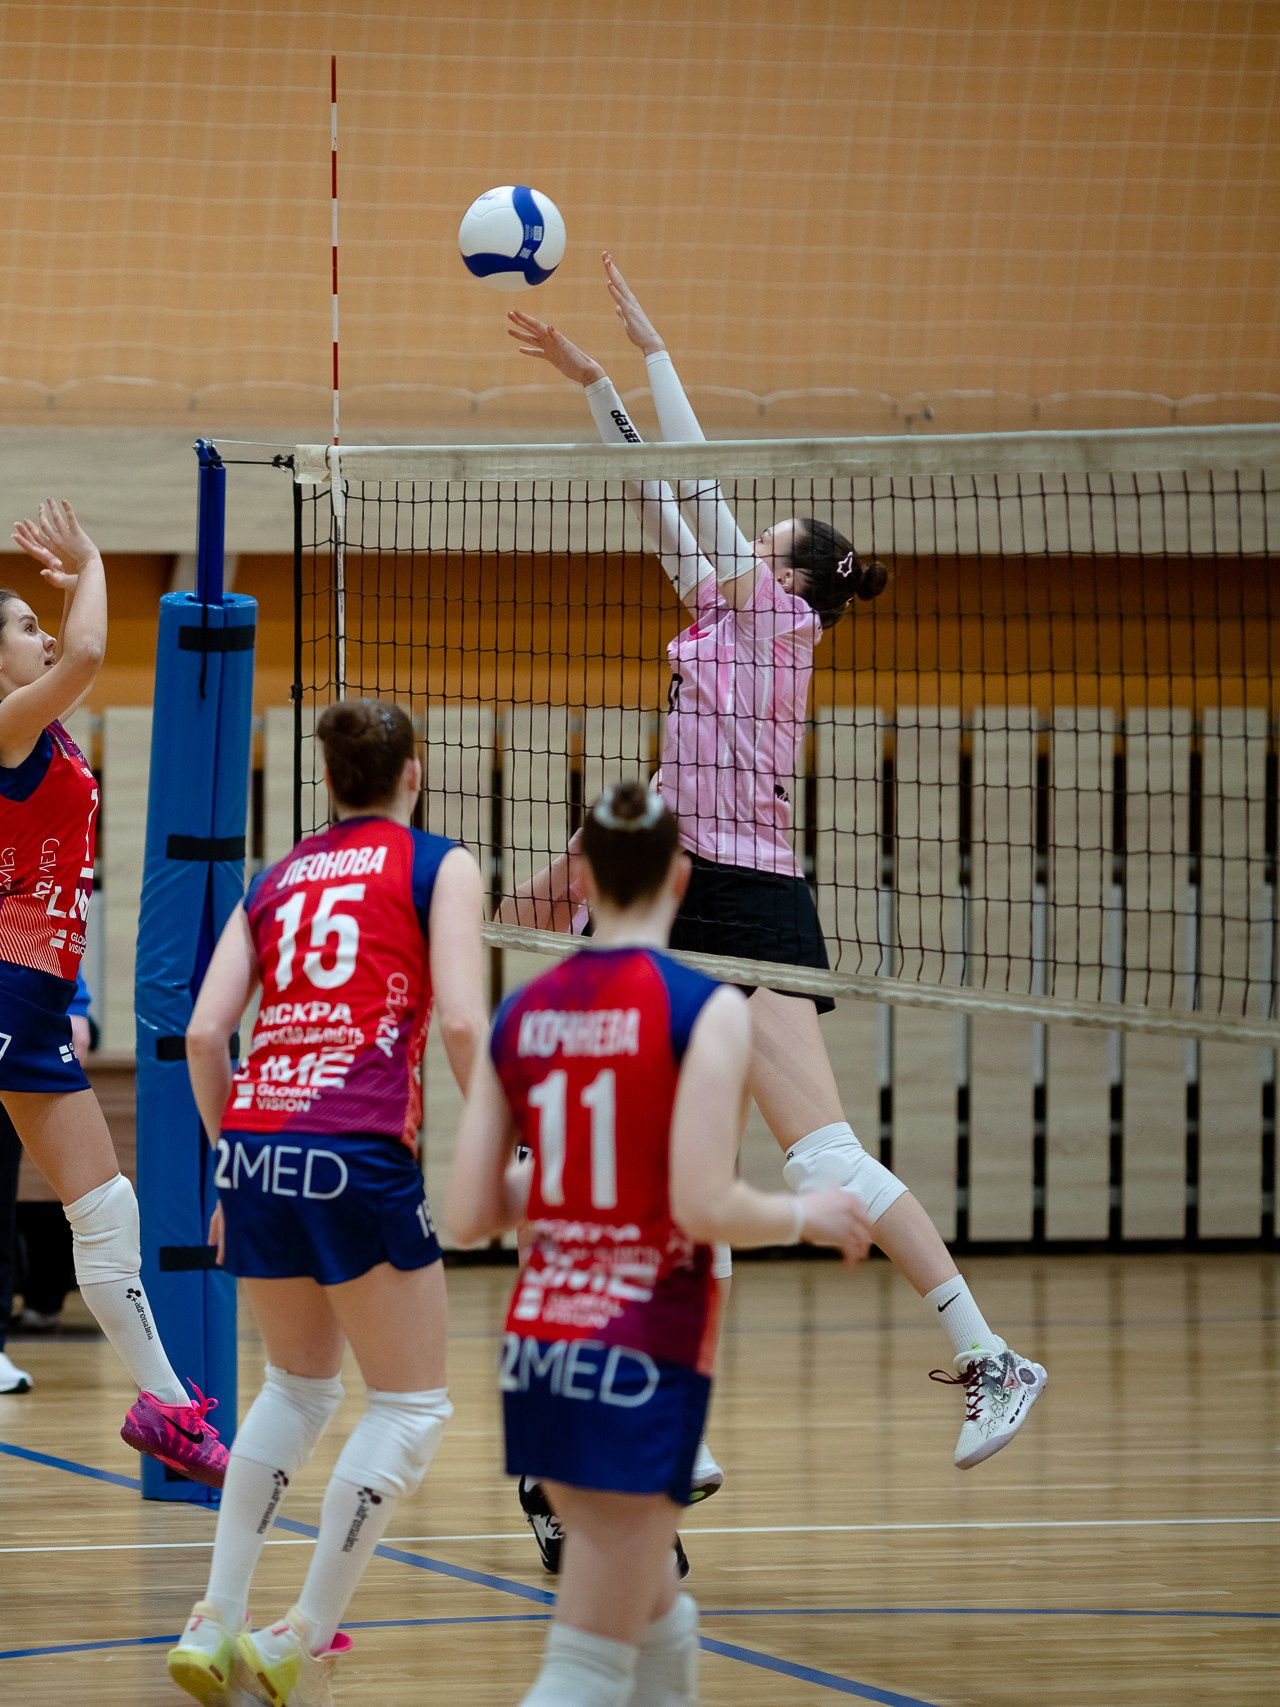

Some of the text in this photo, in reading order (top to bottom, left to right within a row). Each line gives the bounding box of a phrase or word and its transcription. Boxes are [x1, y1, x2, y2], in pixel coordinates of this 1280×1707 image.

[276, 846, 388, 889] ЛЕОНОВА
[275, 883, 366, 992] 15
[256, 1083, 322, 1100] GLOBAL
[256, 1097, 311, 1112] VISION
[527, 1068, 617, 1209] 11
